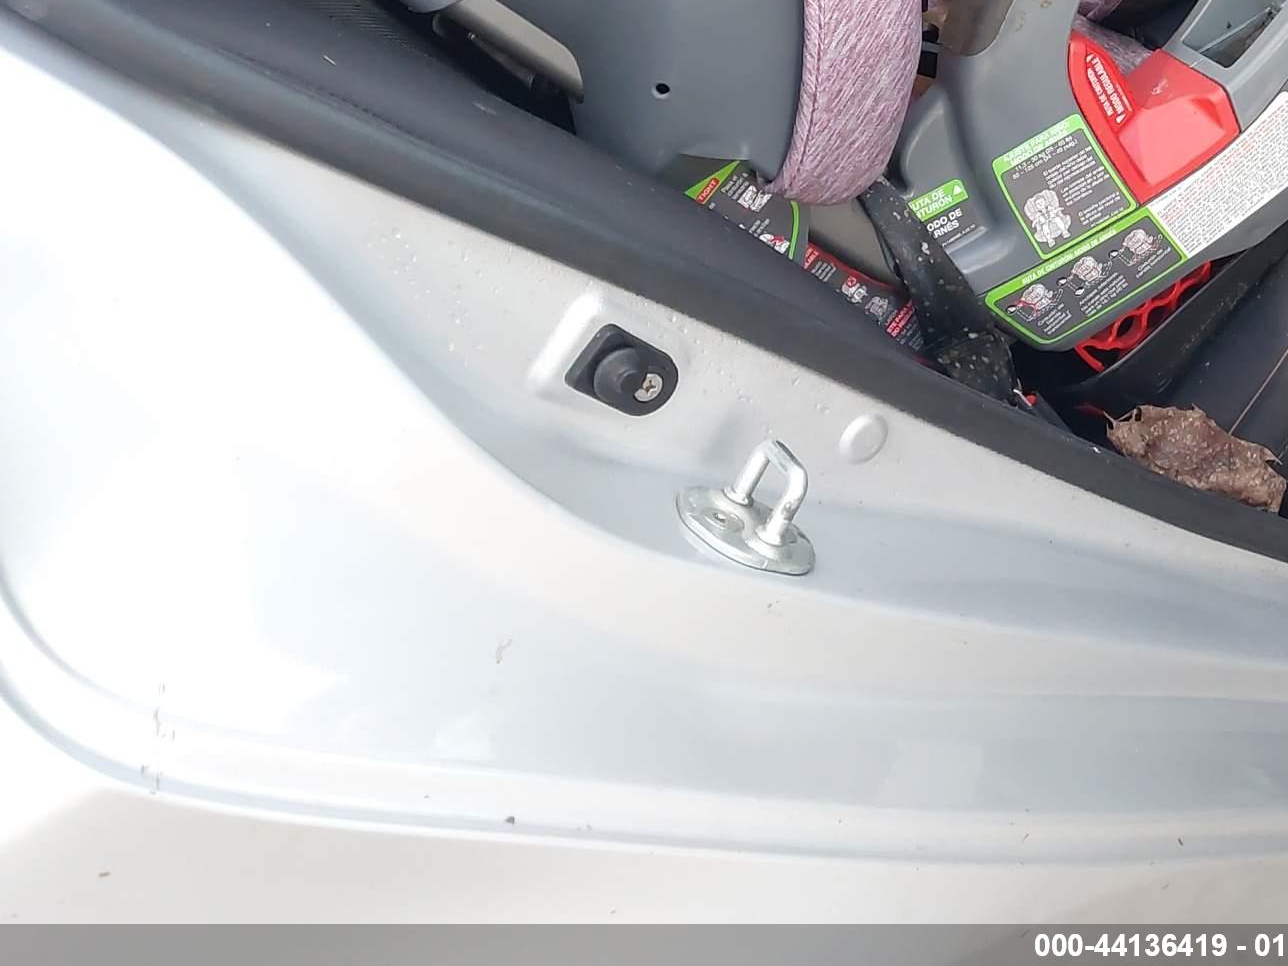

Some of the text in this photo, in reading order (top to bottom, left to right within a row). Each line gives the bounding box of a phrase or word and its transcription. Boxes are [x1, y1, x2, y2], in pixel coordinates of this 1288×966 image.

[697, 179, 717, 201] TIGHT
[912, 188, 945, 211] UTA DE
[926, 208, 963, 231] ODO DE
[933, 220, 960, 239] RNÉS
